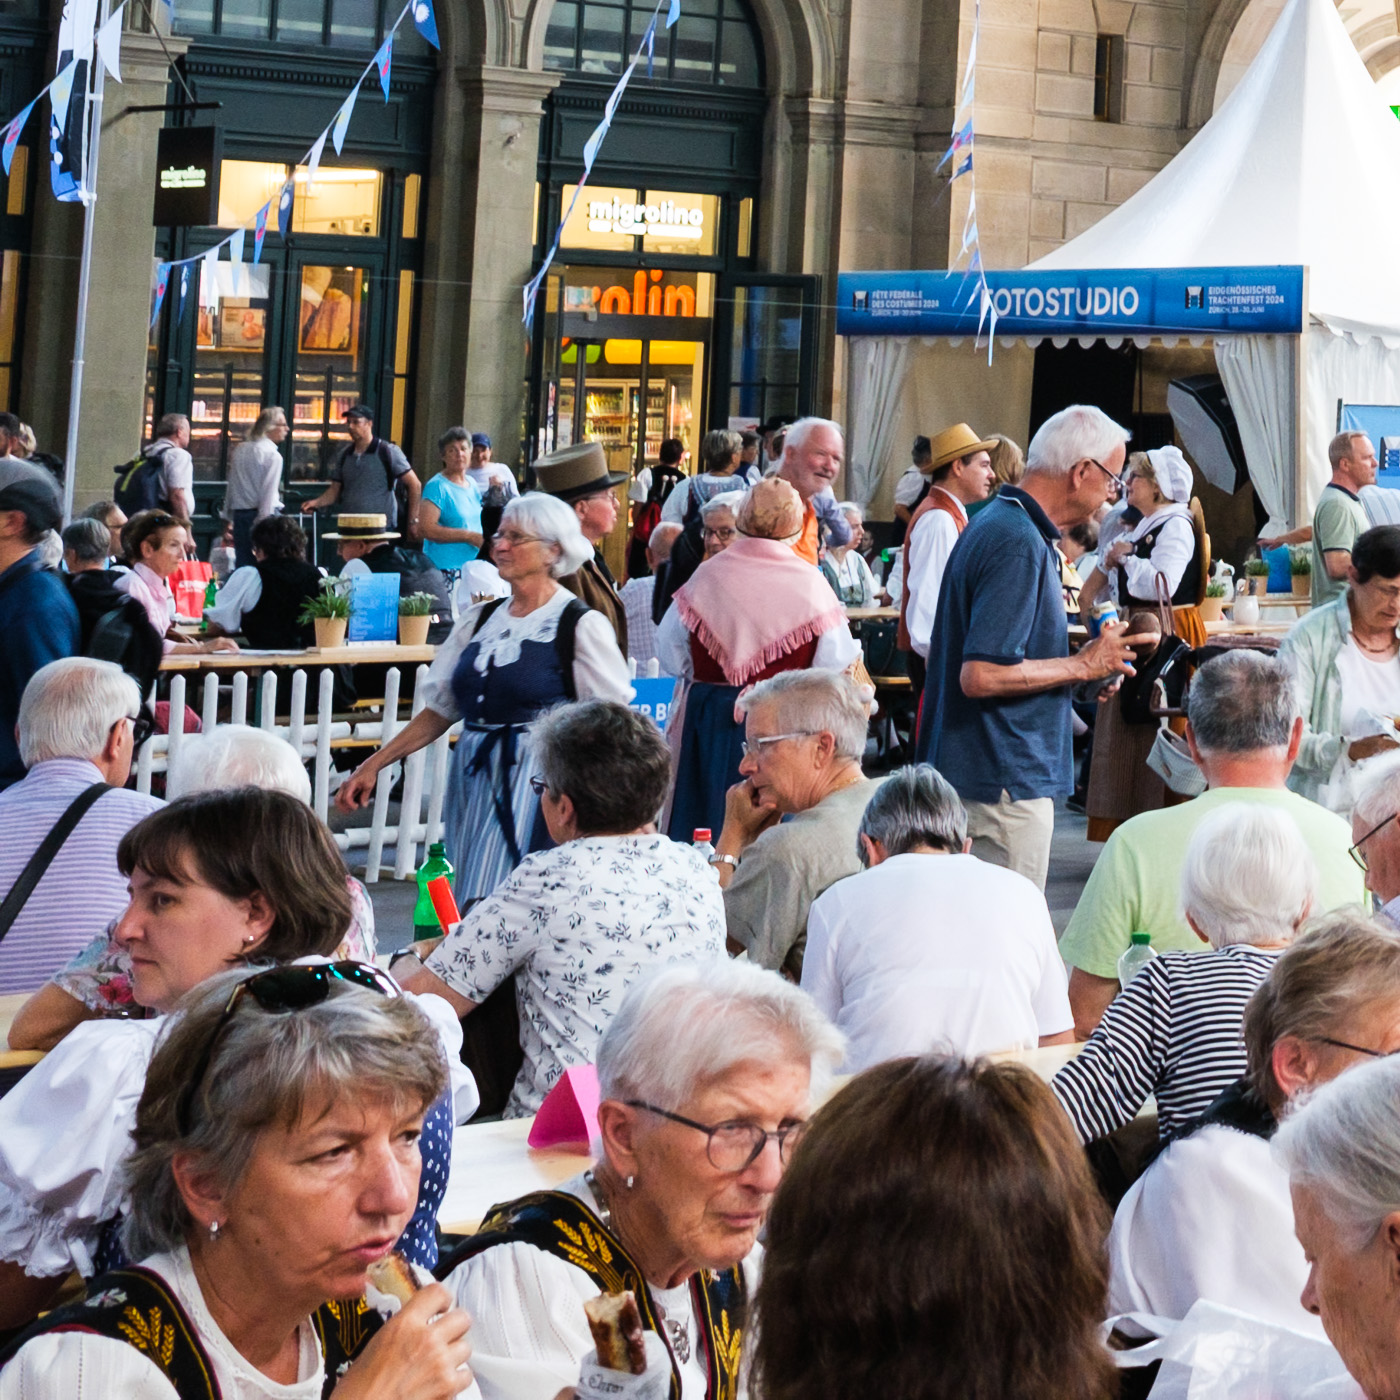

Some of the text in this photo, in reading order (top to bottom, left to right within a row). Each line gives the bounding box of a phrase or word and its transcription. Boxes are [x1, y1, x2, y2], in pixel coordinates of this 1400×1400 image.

[588, 196, 704, 228] migrolino
[1208, 285, 1277, 295] EIDGENÖSSISCHES
[872, 299, 940, 308] DES COSTUMES 2024
[1208, 295, 1284, 304] TRACHTENFEST 2024
